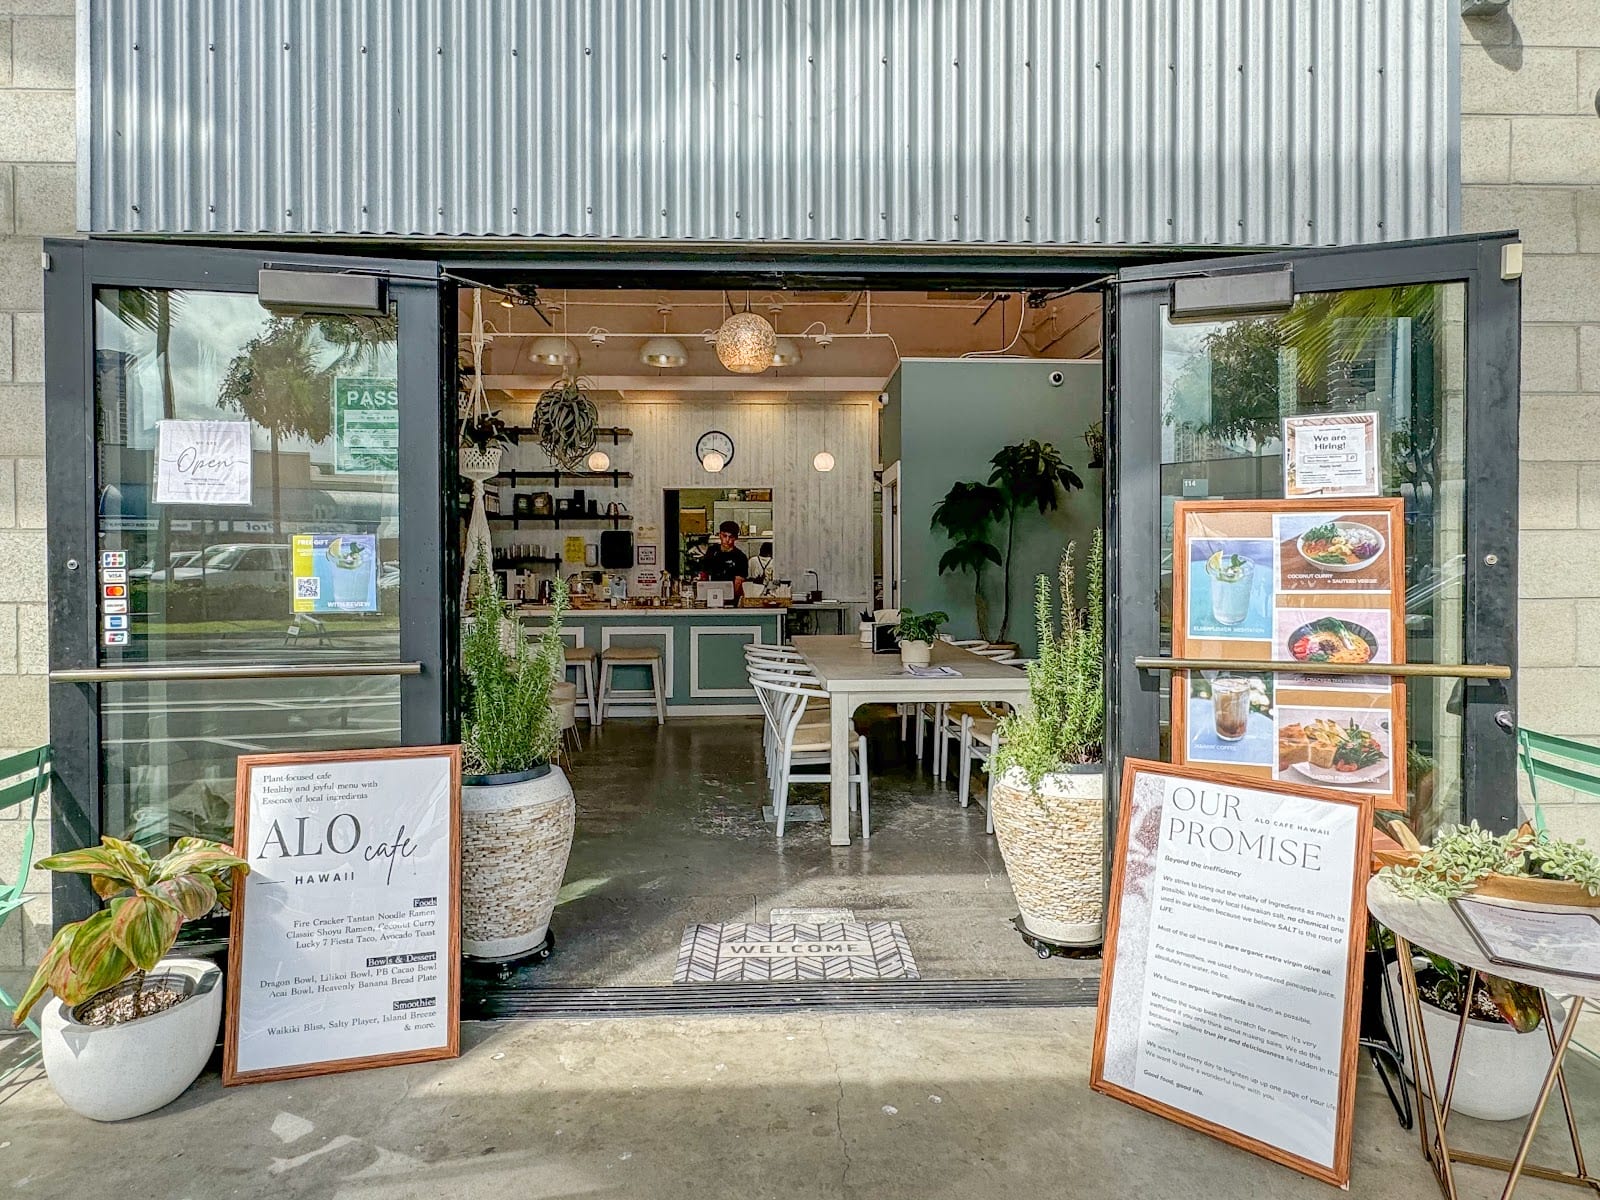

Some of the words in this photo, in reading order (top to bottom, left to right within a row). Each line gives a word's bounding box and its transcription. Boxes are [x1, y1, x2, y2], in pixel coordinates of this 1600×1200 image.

[347, 391, 398, 405] PASS
[1314, 442, 1346, 450] Hiring!
[177, 446, 233, 475] Open
[262, 785, 293, 794] Healthy
[295, 784, 310, 792] and
[312, 782, 334, 793] joyful
[361, 780, 378, 788] with
[263, 773, 314, 783] Plant-focused
[317, 772, 332, 780] cafe
[262, 797, 293, 805] Essence
[306, 794, 323, 803] local
[326, 793, 368, 802] ingredients
[1172, 786, 1243, 821] OUR
[1254, 817, 1270, 825] ALO
[1273, 820, 1294, 830] CAFE
[1297, 825, 1330, 836] HAWAII
[256, 813, 361, 859] ALO
[364, 825, 418, 885] cafe
[1168, 817, 1321, 872] PROMISE
[1164, 856, 1189, 867] Beyond
[1202, 864, 1241, 878] inefficiency
[295, 871, 355, 885] HAWAII
[1174, 877, 1189, 886] strive
[1198, 883, 1213, 892] bring
[1238, 892, 1258, 903] vitality
[1316, 910, 1335, 919] much
[293, 920, 310, 928] Fire
[313, 917, 344, 926] Cracker
[347, 914, 375, 923] Tantan
[378, 911, 406, 920] Noodle
[409, 909, 436, 918] Ramen
[1160, 895, 1174, 903] used
[1192, 903, 1214, 913] kitchen
[1215, 908, 1240, 919] because
[1253, 918, 1276, 928] believe
[1277, 923, 1297, 933] SALT
[1305, 930, 1316, 938] the
[1318, 933, 1332, 942] root
[1210, 897, 1224, 906] only
[1225, 900, 1239, 908] local
[1241, 904, 1271, 916] Hawaiian
[1272, 911, 1285, 920] salt,
[1297, 917, 1328, 929] chemical
[286, 930, 314, 939] Classic
[317, 928, 342, 938] Shoyu
[345, 925, 376, 934] Ramen,
[413, 919, 436, 928] Curry
[296, 940, 320, 949] Lucky
[330, 936, 354, 945] Fiesta
[357, 935, 377, 944] Taco,
[380, 932, 412, 941] Avocado
[414, 929, 436, 937] Toast
[406, 952, 437, 963] Dessert
[730, 944, 860, 954] WELCOME
[1224, 943, 1239, 951] pure
[1240, 946, 1263, 958] organic
[1265, 952, 1281, 961] extra
[1283, 957, 1302, 968] virgin
[1304, 962, 1320, 972] olive
[1321, 967, 1332, 975] oil.
[260, 980, 291, 989] Dragon
[294, 976, 317, 985] Bowl,
[320, 973, 347, 982] Lilikoi
[350, 970, 373, 980] Bowl,
[376, 968, 389, 976] PB
[391, 966, 415, 975] Cacao
[418, 963, 437, 972] Bowl
[291, 985, 315, 995] Bowl,
[317, 982, 355, 993] Heavenly
[358, 979, 388, 989] Banana
[391, 976, 415, 985] Bread
[417, 974, 437, 982] Plate
[393, 997, 437, 1010] Smoothies
[1163, 975, 1178, 984] focus
[1188, 982, 1209, 995] organic
[1211, 989, 1245, 1006] ingredients
[1255, 1002, 1273, 1013] much
[1283, 1011, 1312, 1026] possible.
[267, 1025, 300, 1036] Waikiki
[304, 1022, 326, 1033] Bliss,
[329, 1020, 349, 1031] Salty
[352, 1017, 380, 1027] Player,
[382, 1013, 407, 1023] Island
[410, 1010, 436, 1020] Breeze
[404, 1023, 412, 1031] &
[414, 1022, 436, 1030] more.
[1143, 1068, 1159, 1079] Good
[1175, 1080, 1191, 1092] good
[1192, 1086, 1203, 1095] life.
